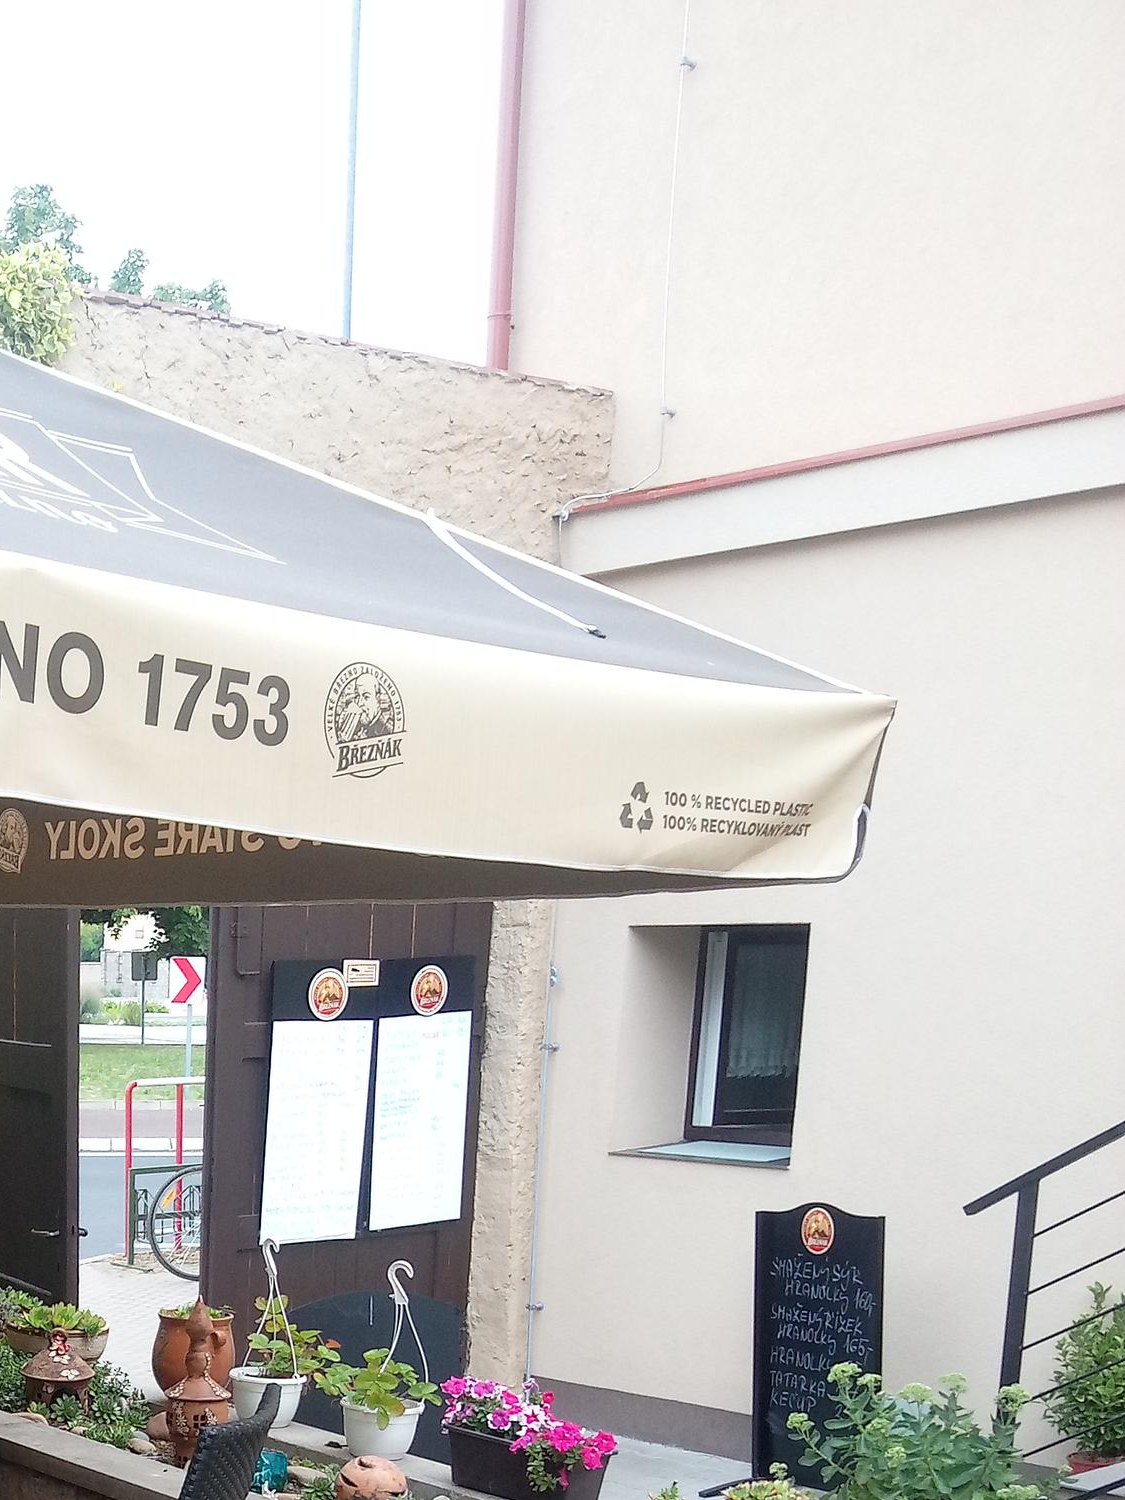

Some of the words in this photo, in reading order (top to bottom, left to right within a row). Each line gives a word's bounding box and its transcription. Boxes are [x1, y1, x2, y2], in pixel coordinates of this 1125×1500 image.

[137, 653, 291, 747] 1753
[335, 737, 403, 773] BŘEZŇÁK
[664, 791, 688, 808] 100
[691, 793, 702, 809] %
[704, 794, 771, 815] RECYCLED
[772, 800, 814, 817] PLASTIC
[662, 814, 697, 832] 100%
[700, 816, 785, 838] RECYKLOVANÝ
[780, 822, 812, 838] PLAST
[769, 1370, 826, 1398] TATARKA
